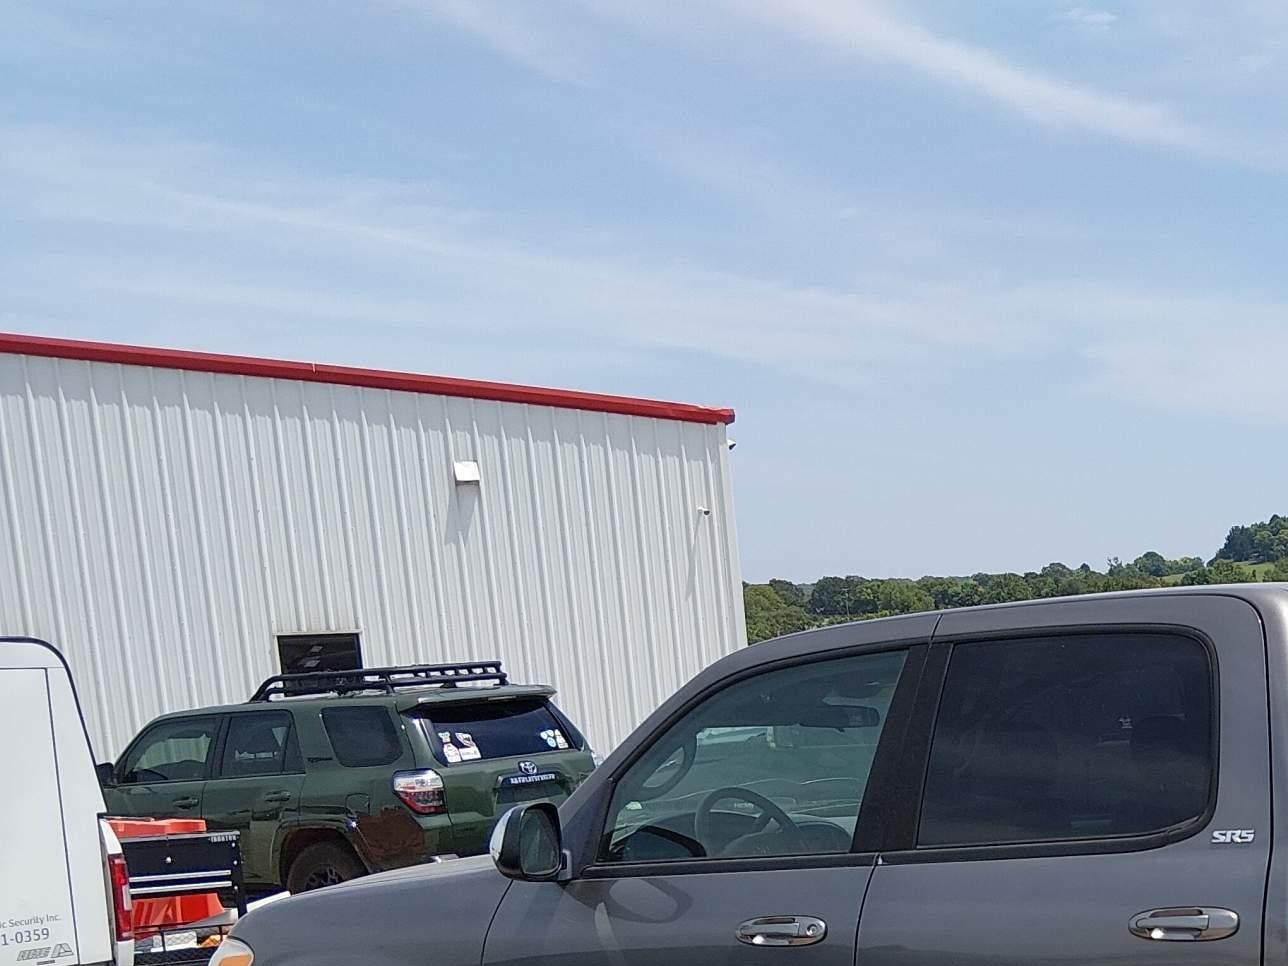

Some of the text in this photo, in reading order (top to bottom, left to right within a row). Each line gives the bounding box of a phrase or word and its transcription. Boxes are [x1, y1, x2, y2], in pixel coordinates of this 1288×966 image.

[1211, 829, 1255, 843] SR5
[8, 915, 44, 928] Security
[1, 927, 50, 946] 1-0359
